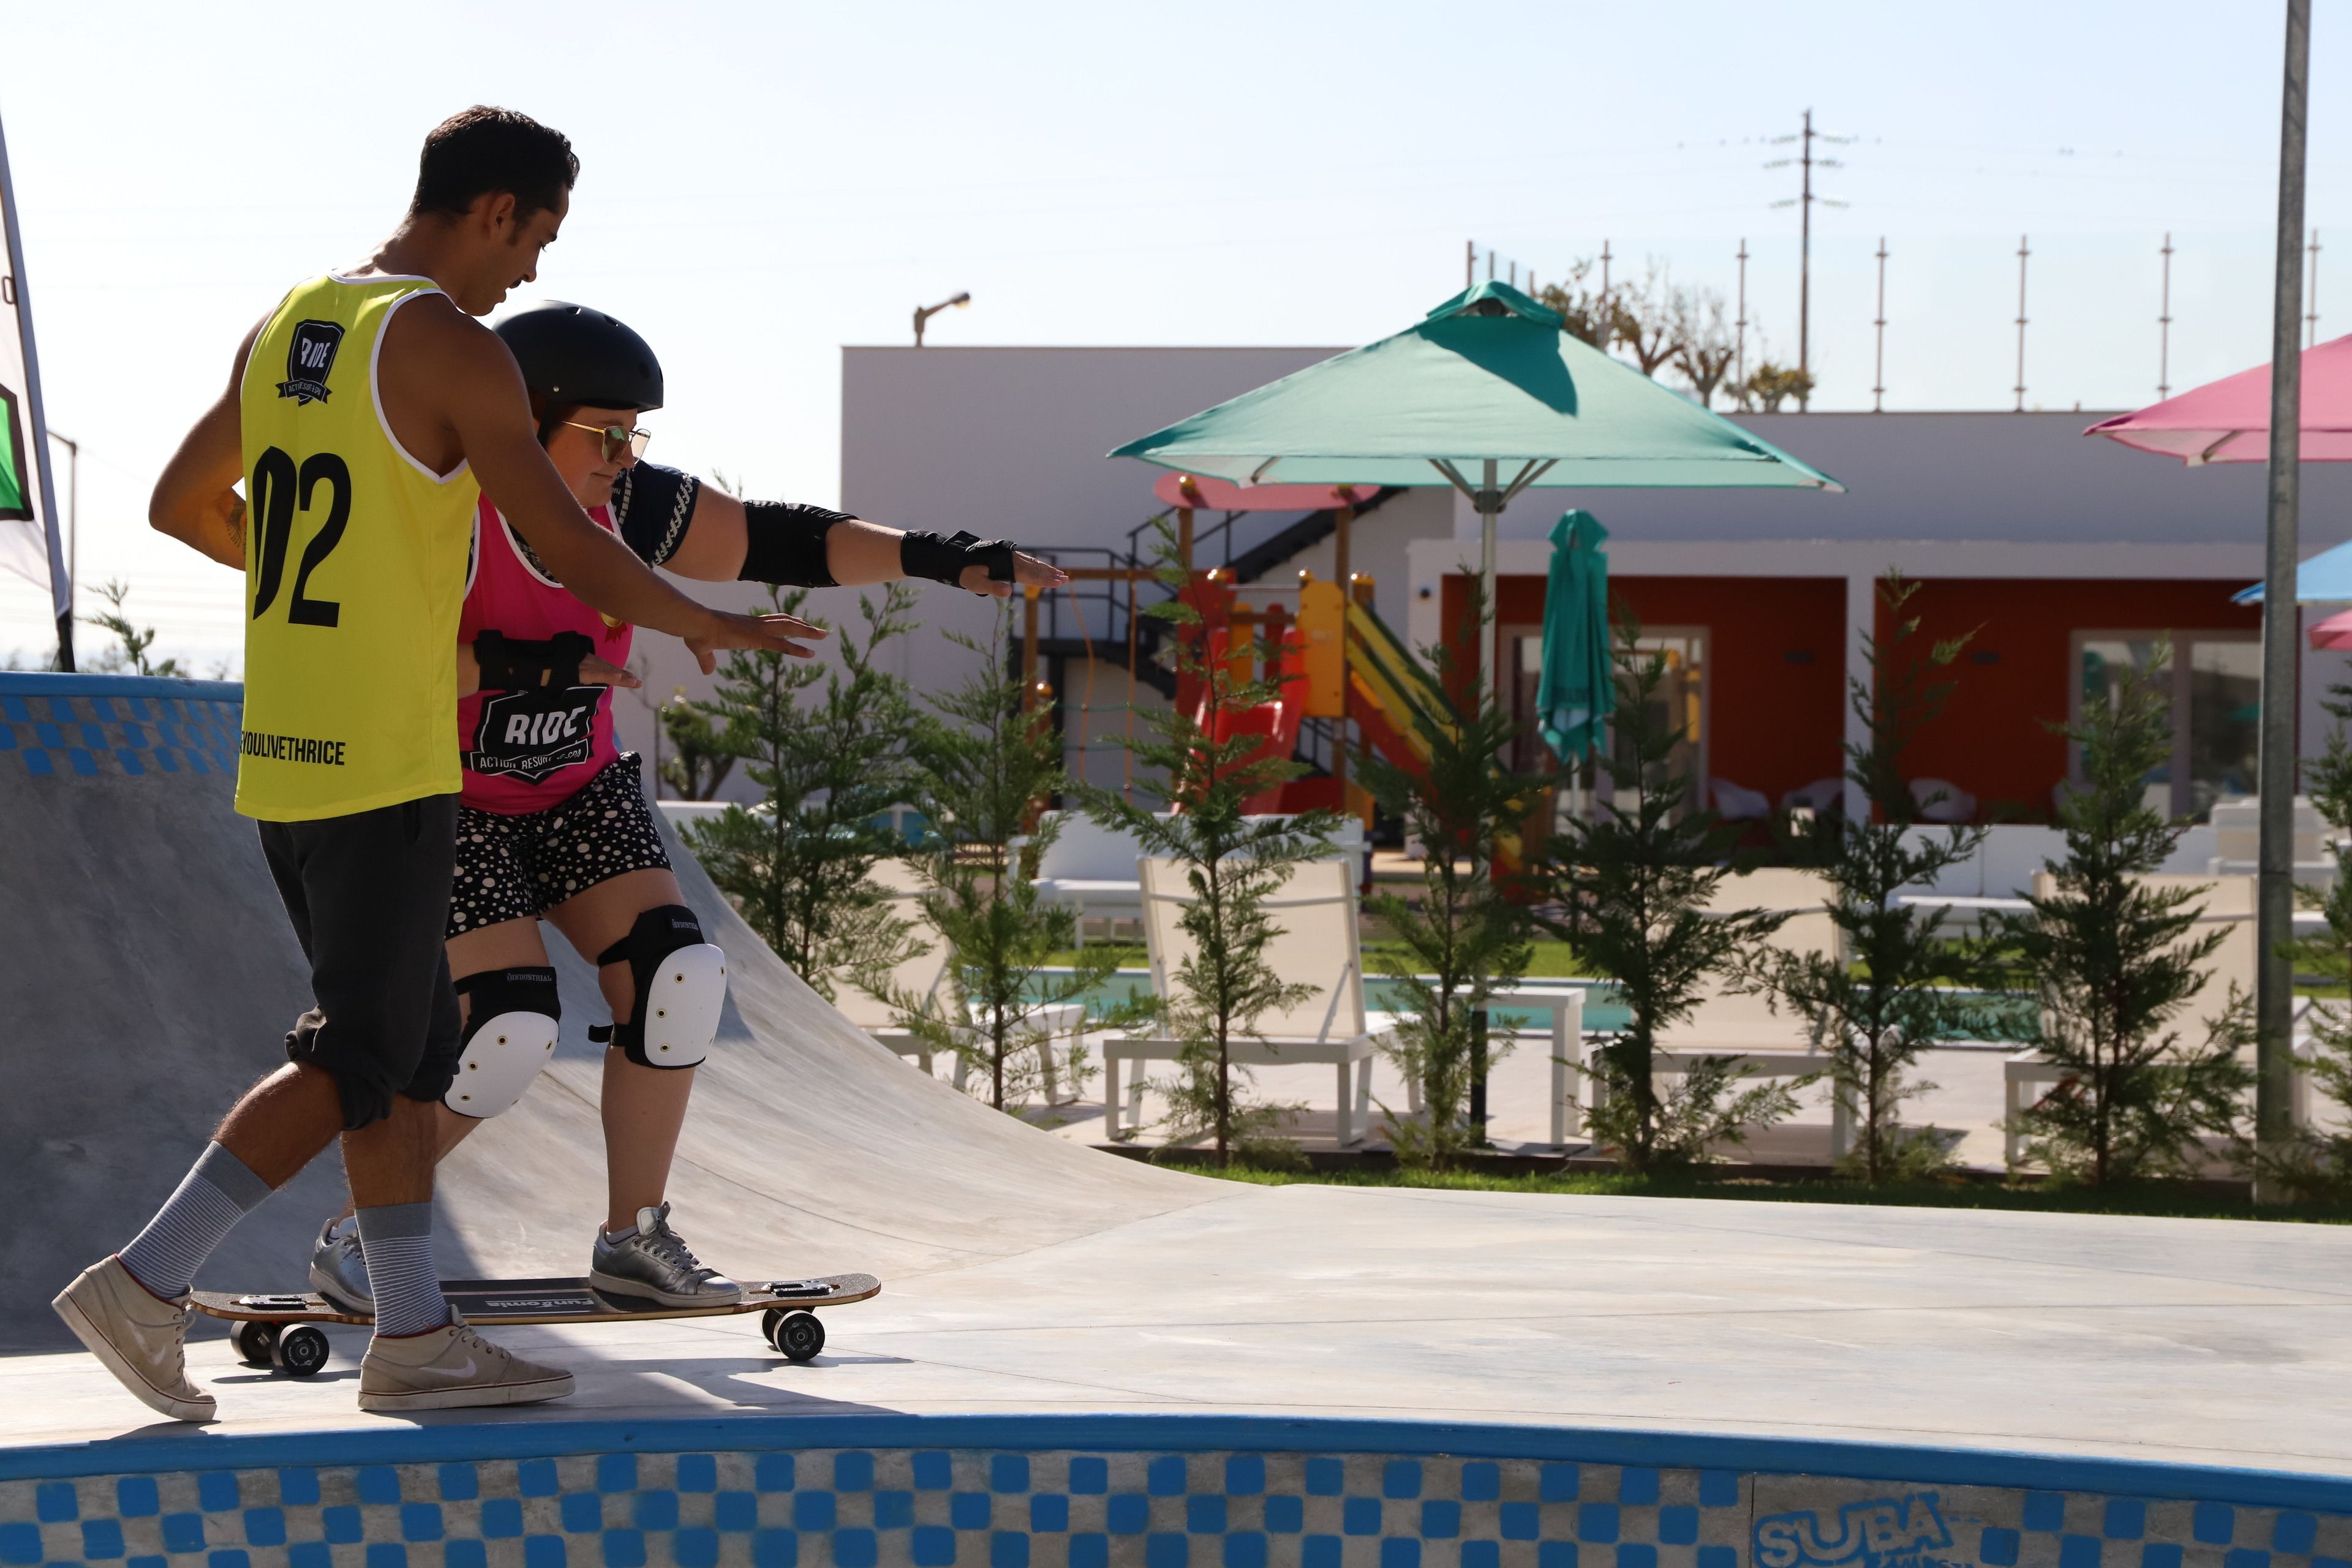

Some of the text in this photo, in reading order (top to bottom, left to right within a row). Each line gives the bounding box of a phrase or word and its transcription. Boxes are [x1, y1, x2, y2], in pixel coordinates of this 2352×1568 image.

[301, 337, 331, 368] RIDE
[252, 445, 352, 628] 02
[505, 706, 587, 745] RIDE
[565, 748, 581, 760] SPA
[1754, 1492, 1953, 1568] SUBA
